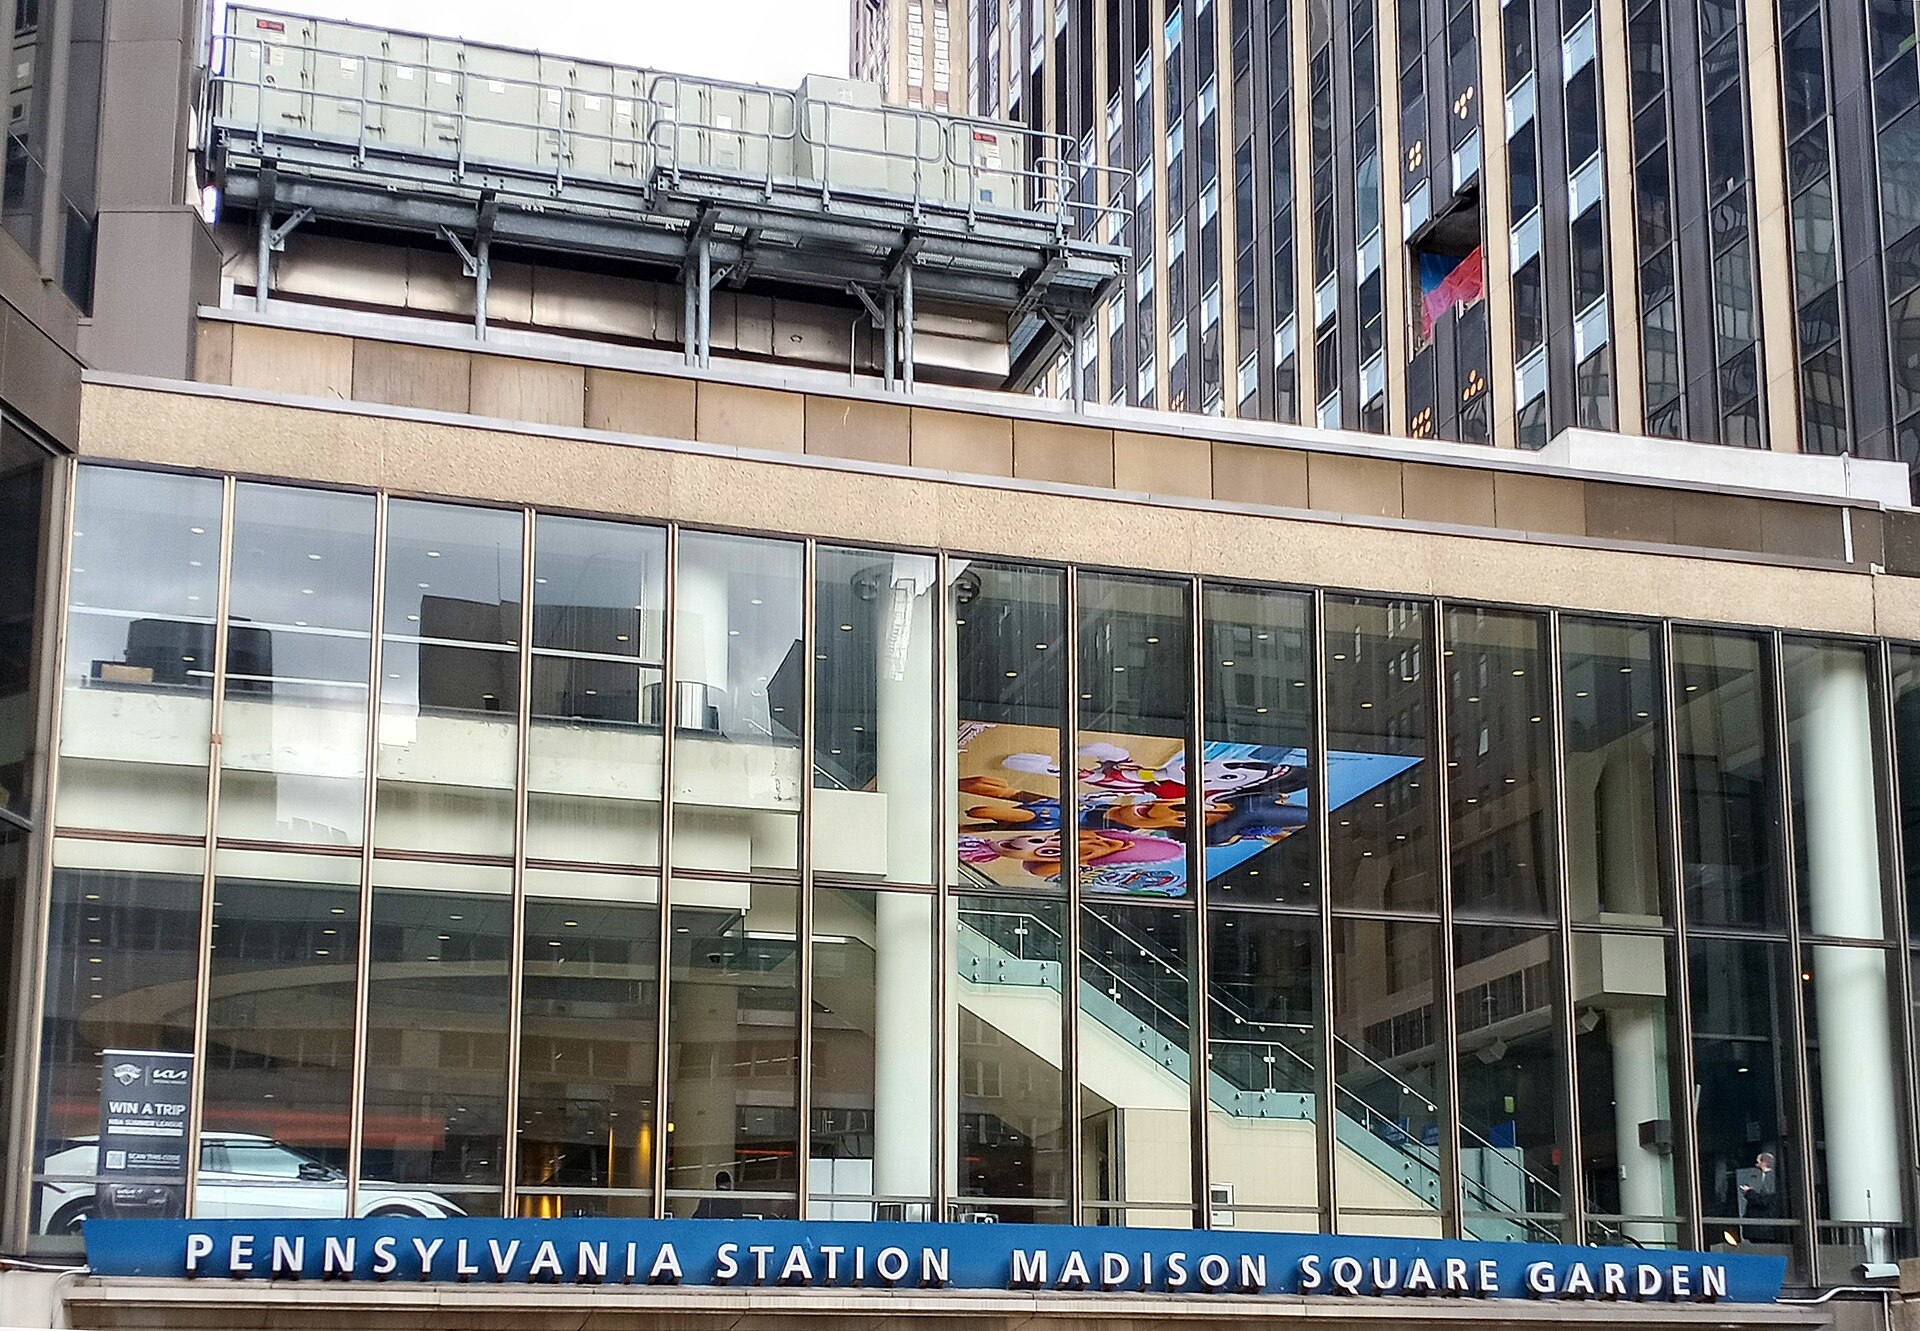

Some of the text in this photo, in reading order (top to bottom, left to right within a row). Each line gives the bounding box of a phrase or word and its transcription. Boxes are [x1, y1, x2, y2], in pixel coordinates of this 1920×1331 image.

[109, 1101, 186, 1116] WIN A TRIP
[186, 1233, 1727, 1297] PENNSYLVANIA STATION MADISON SQUARE GARDEN
